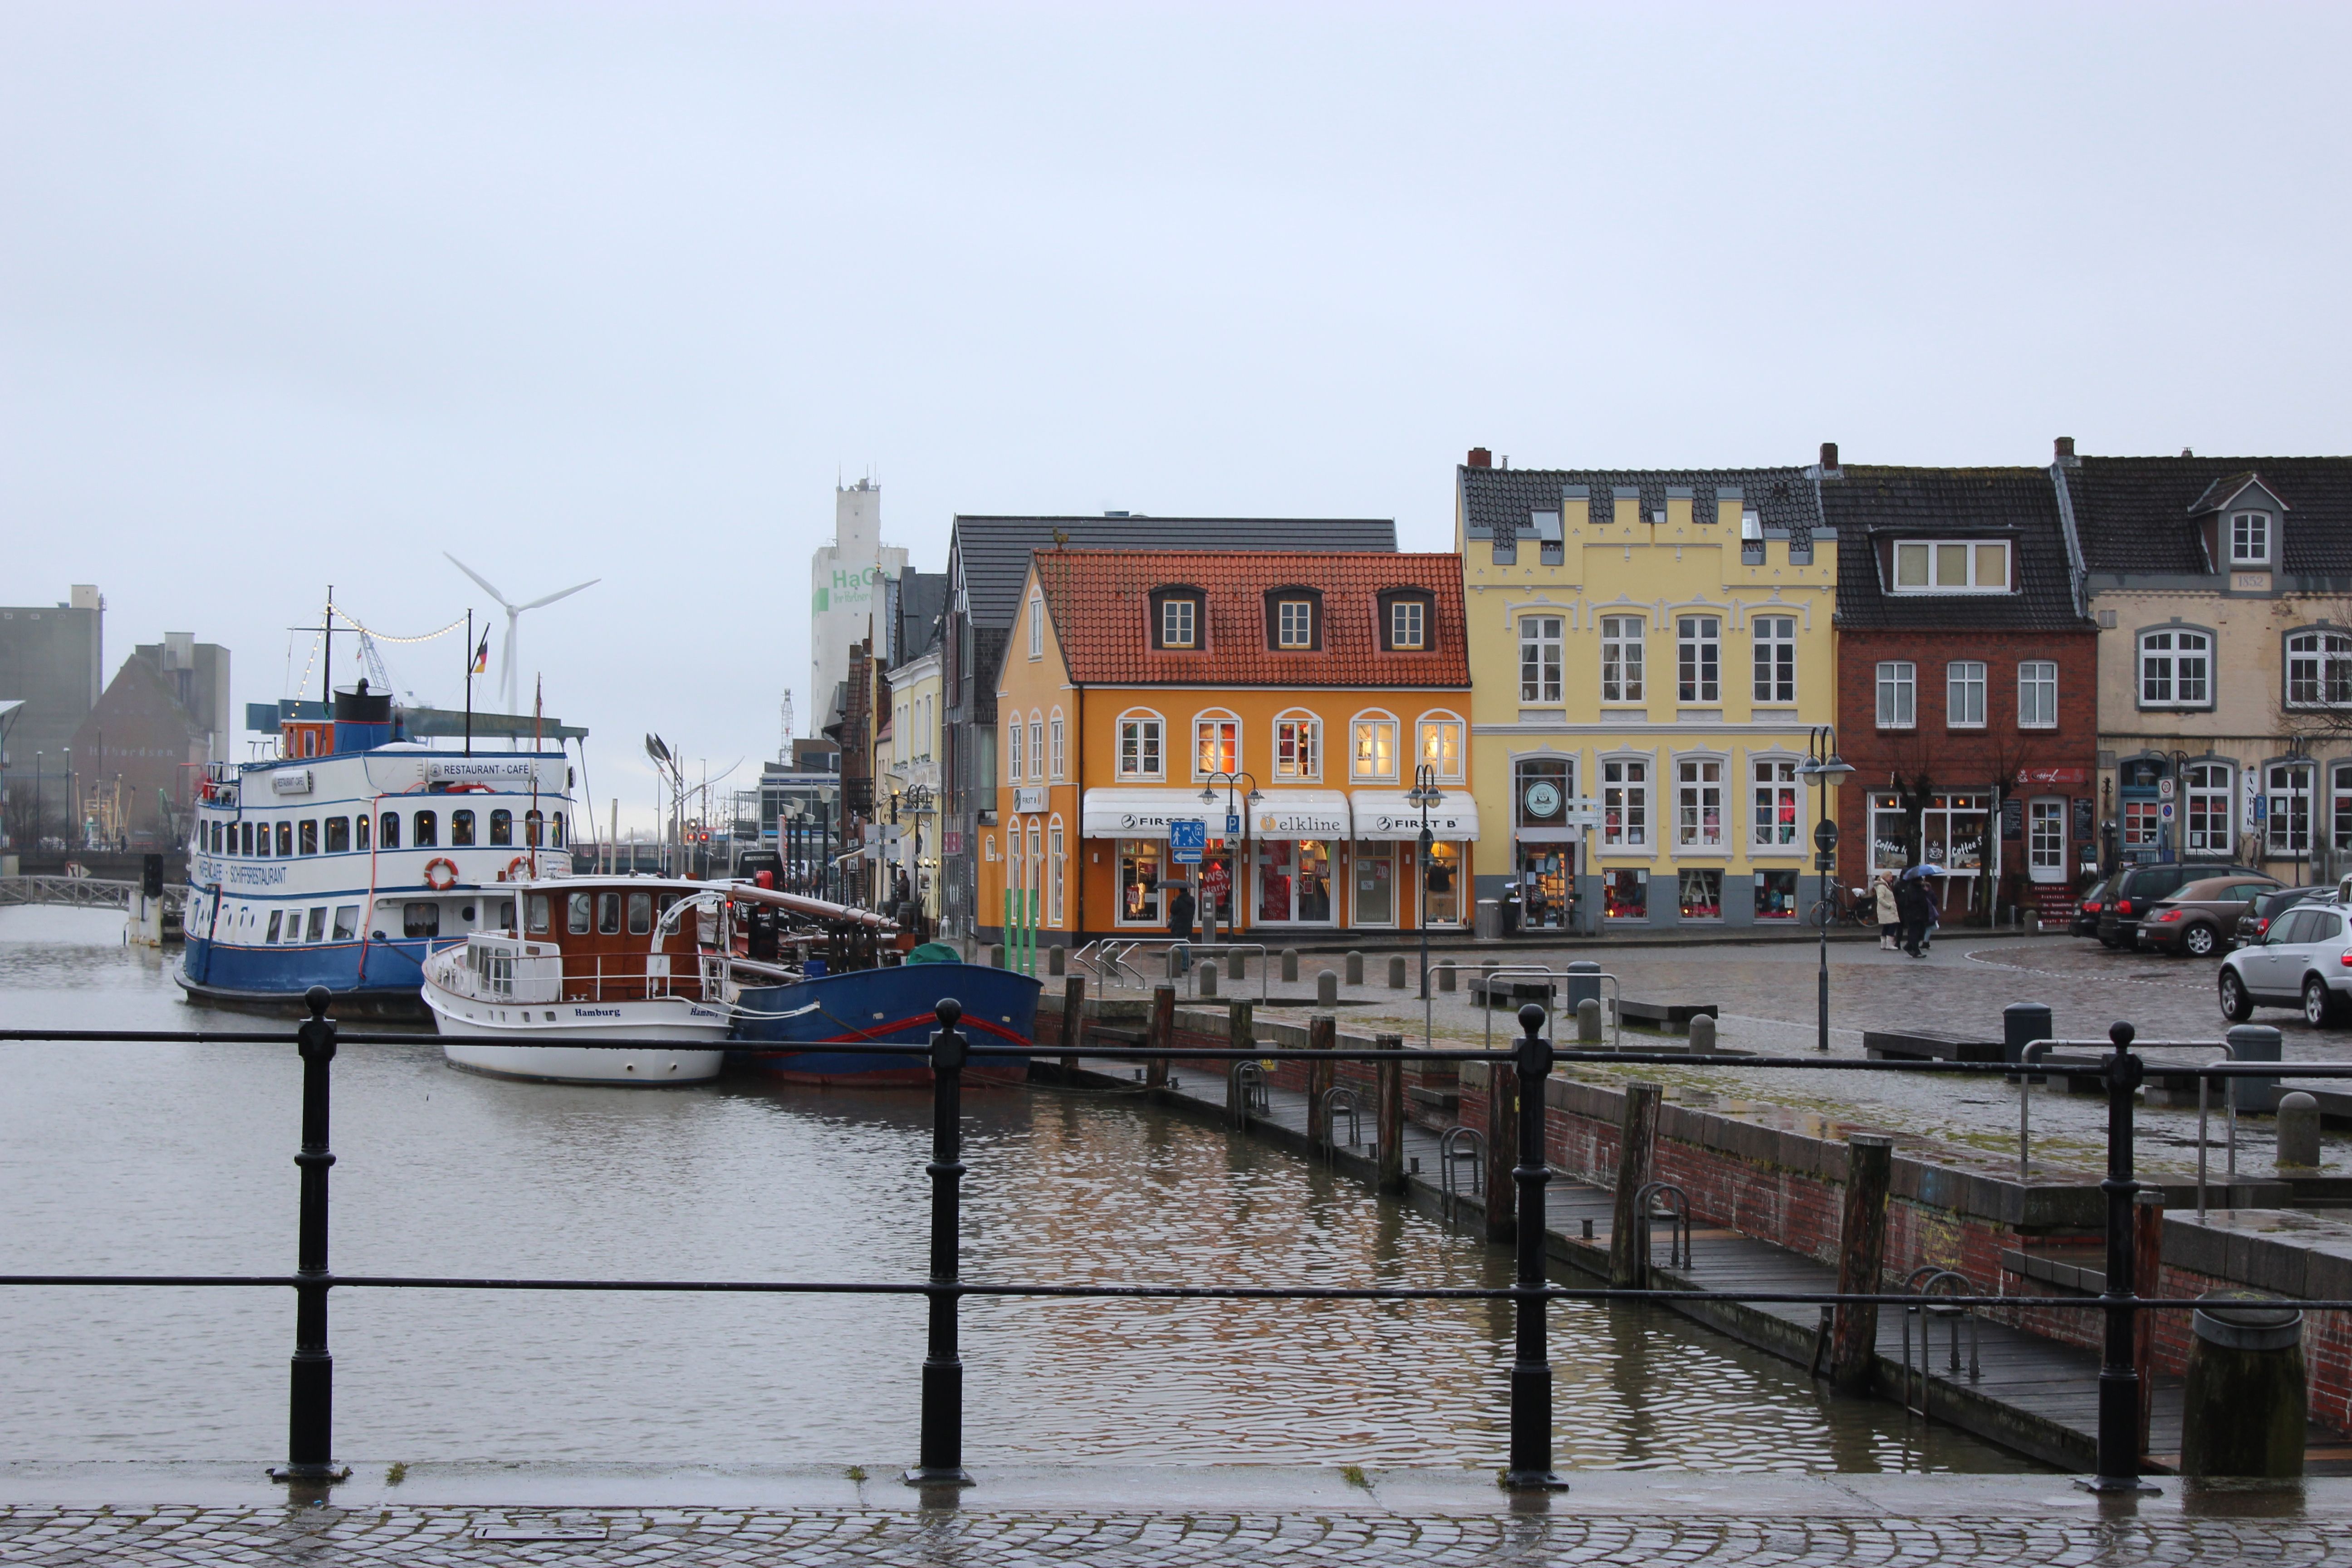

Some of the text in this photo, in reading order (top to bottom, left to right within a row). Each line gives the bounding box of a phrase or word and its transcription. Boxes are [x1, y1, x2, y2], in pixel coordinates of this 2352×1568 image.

[2237, 575, 2263, 587] 1852
[844, 591, 867, 603] Partner
[507, 763, 529, 774] CAFÉ
[1229, 817, 1237, 831] P
[1279, 816, 1340, 831] elkline
[1874, 839, 1899, 852] Coffee
[1951, 842, 1976, 856] Coffee
[230, 865, 286, 886] SCHIFFSRESTAURANT
[1205, 870, 1229, 882] WSV
[575, 1009, 621, 1017] Hamburg
